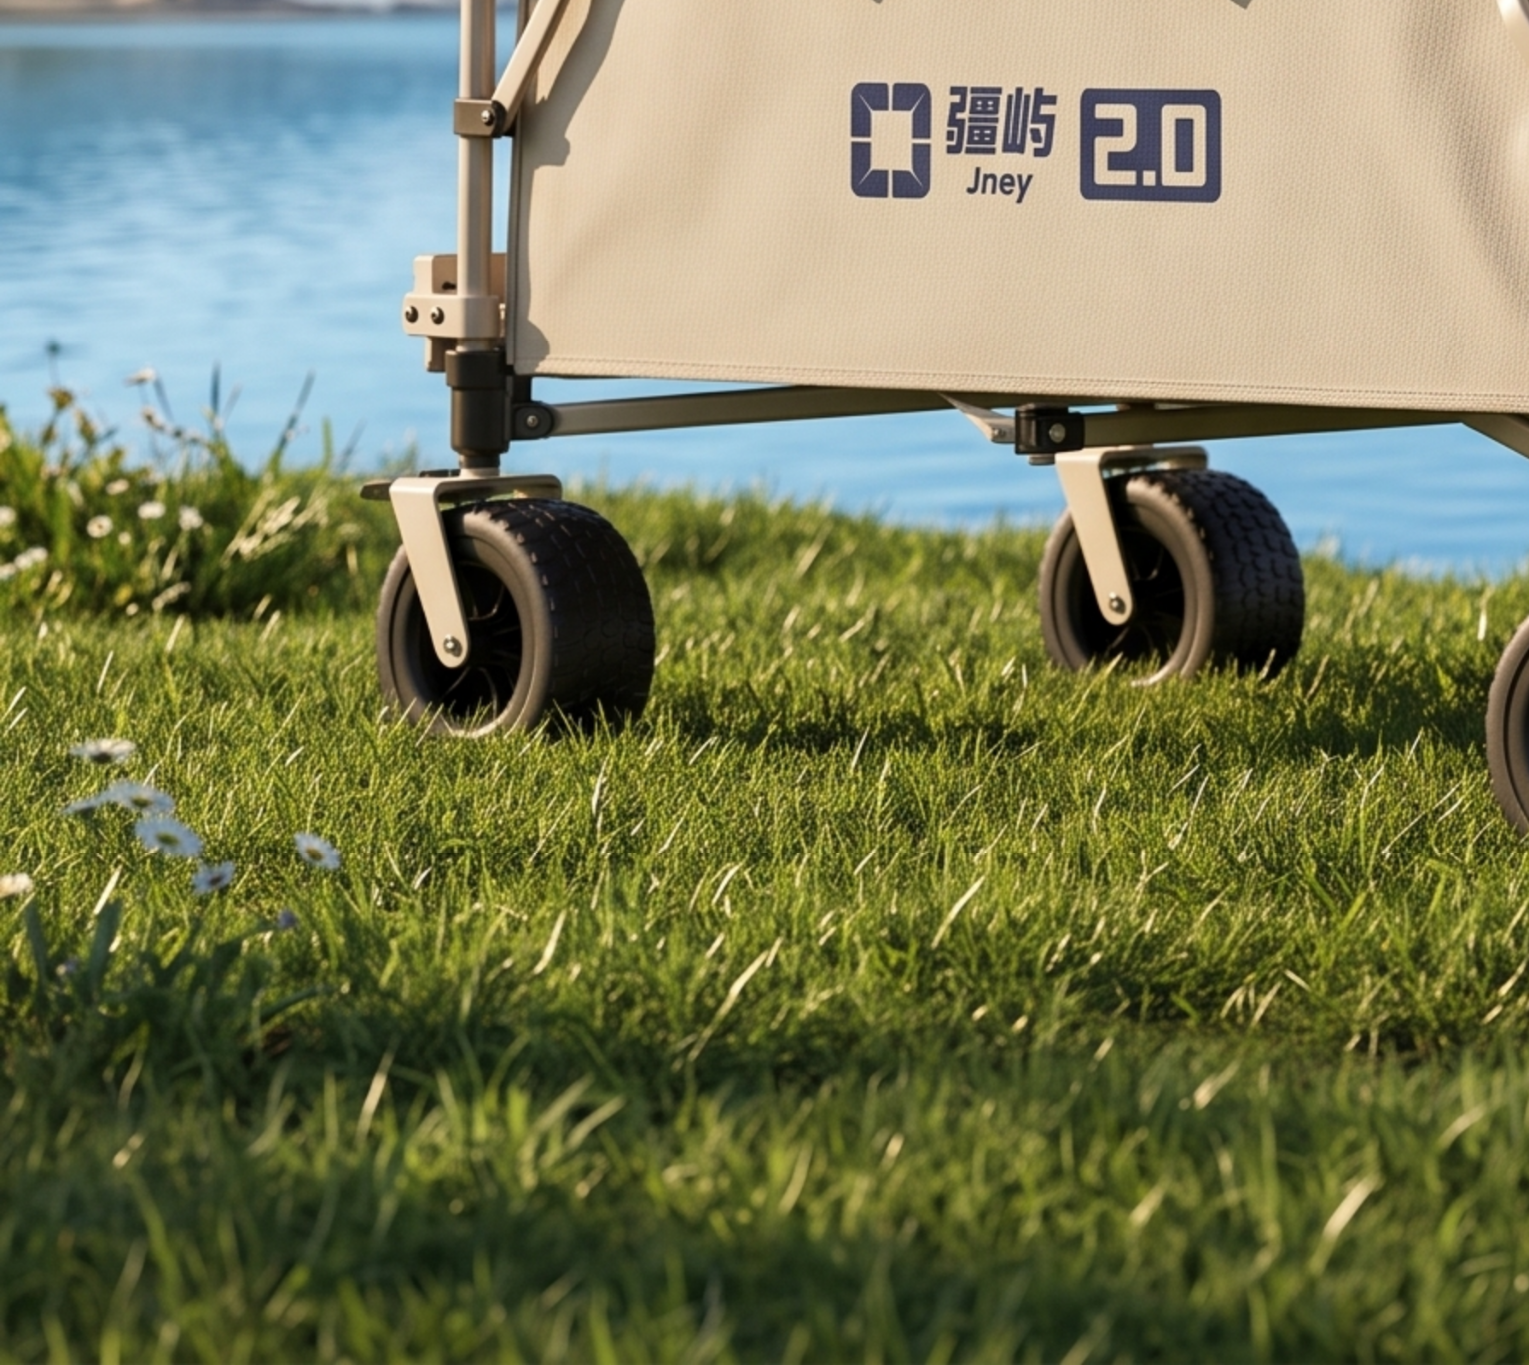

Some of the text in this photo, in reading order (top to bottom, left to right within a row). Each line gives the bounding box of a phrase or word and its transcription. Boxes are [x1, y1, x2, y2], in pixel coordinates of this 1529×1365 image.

[946, 86, 1058, 158] 疆屿
[1093, 102, 1207, 187] 2.0
[966, 166, 1034, 204] Jney
